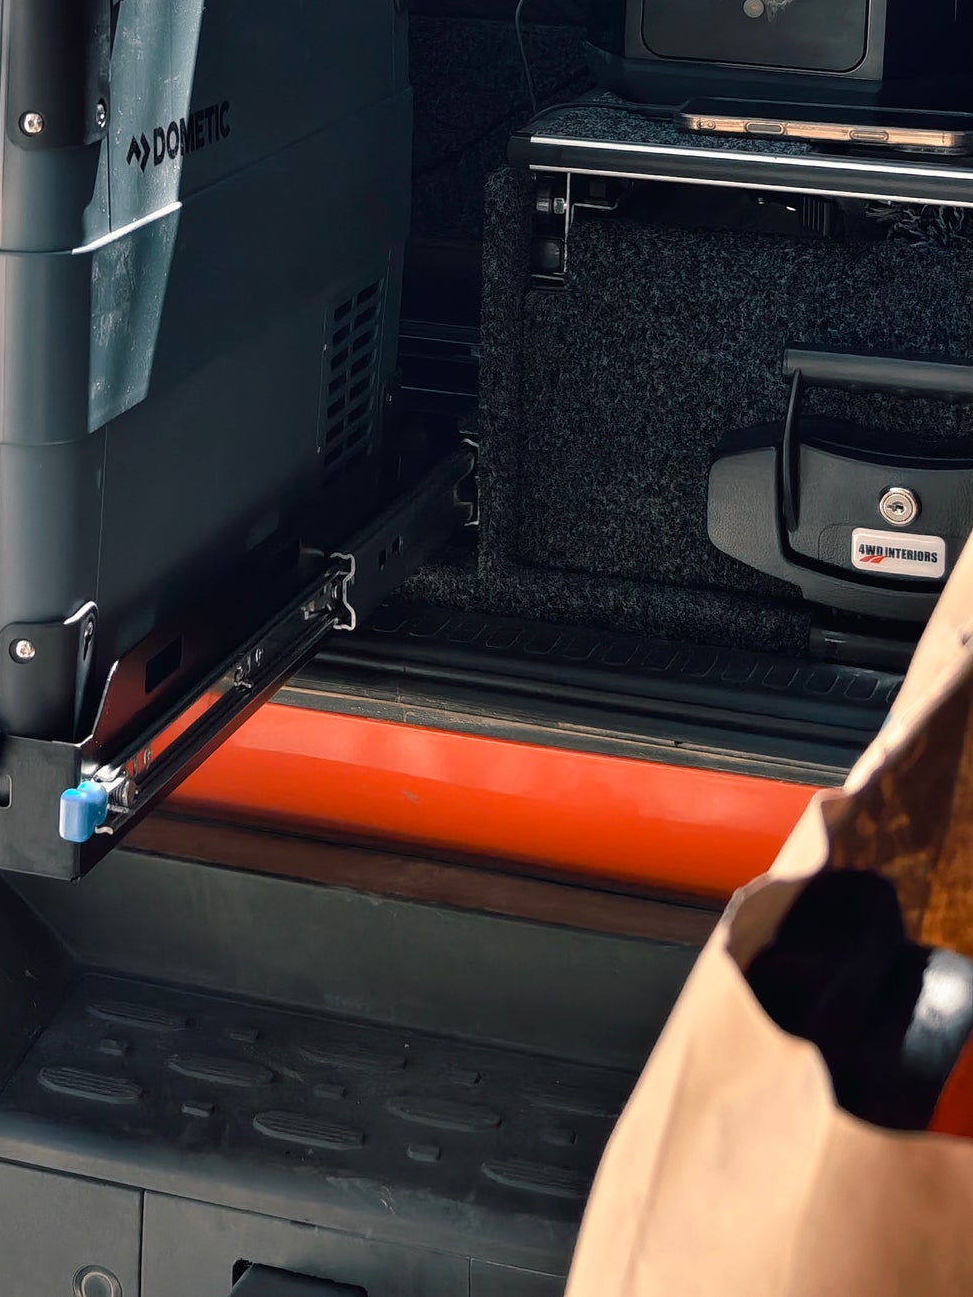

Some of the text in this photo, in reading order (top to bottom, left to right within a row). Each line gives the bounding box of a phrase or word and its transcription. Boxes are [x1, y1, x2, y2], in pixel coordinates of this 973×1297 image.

[153, 100, 231, 167] DOMETIC
[858, 543, 938, 563] 4WD INTERIORS
